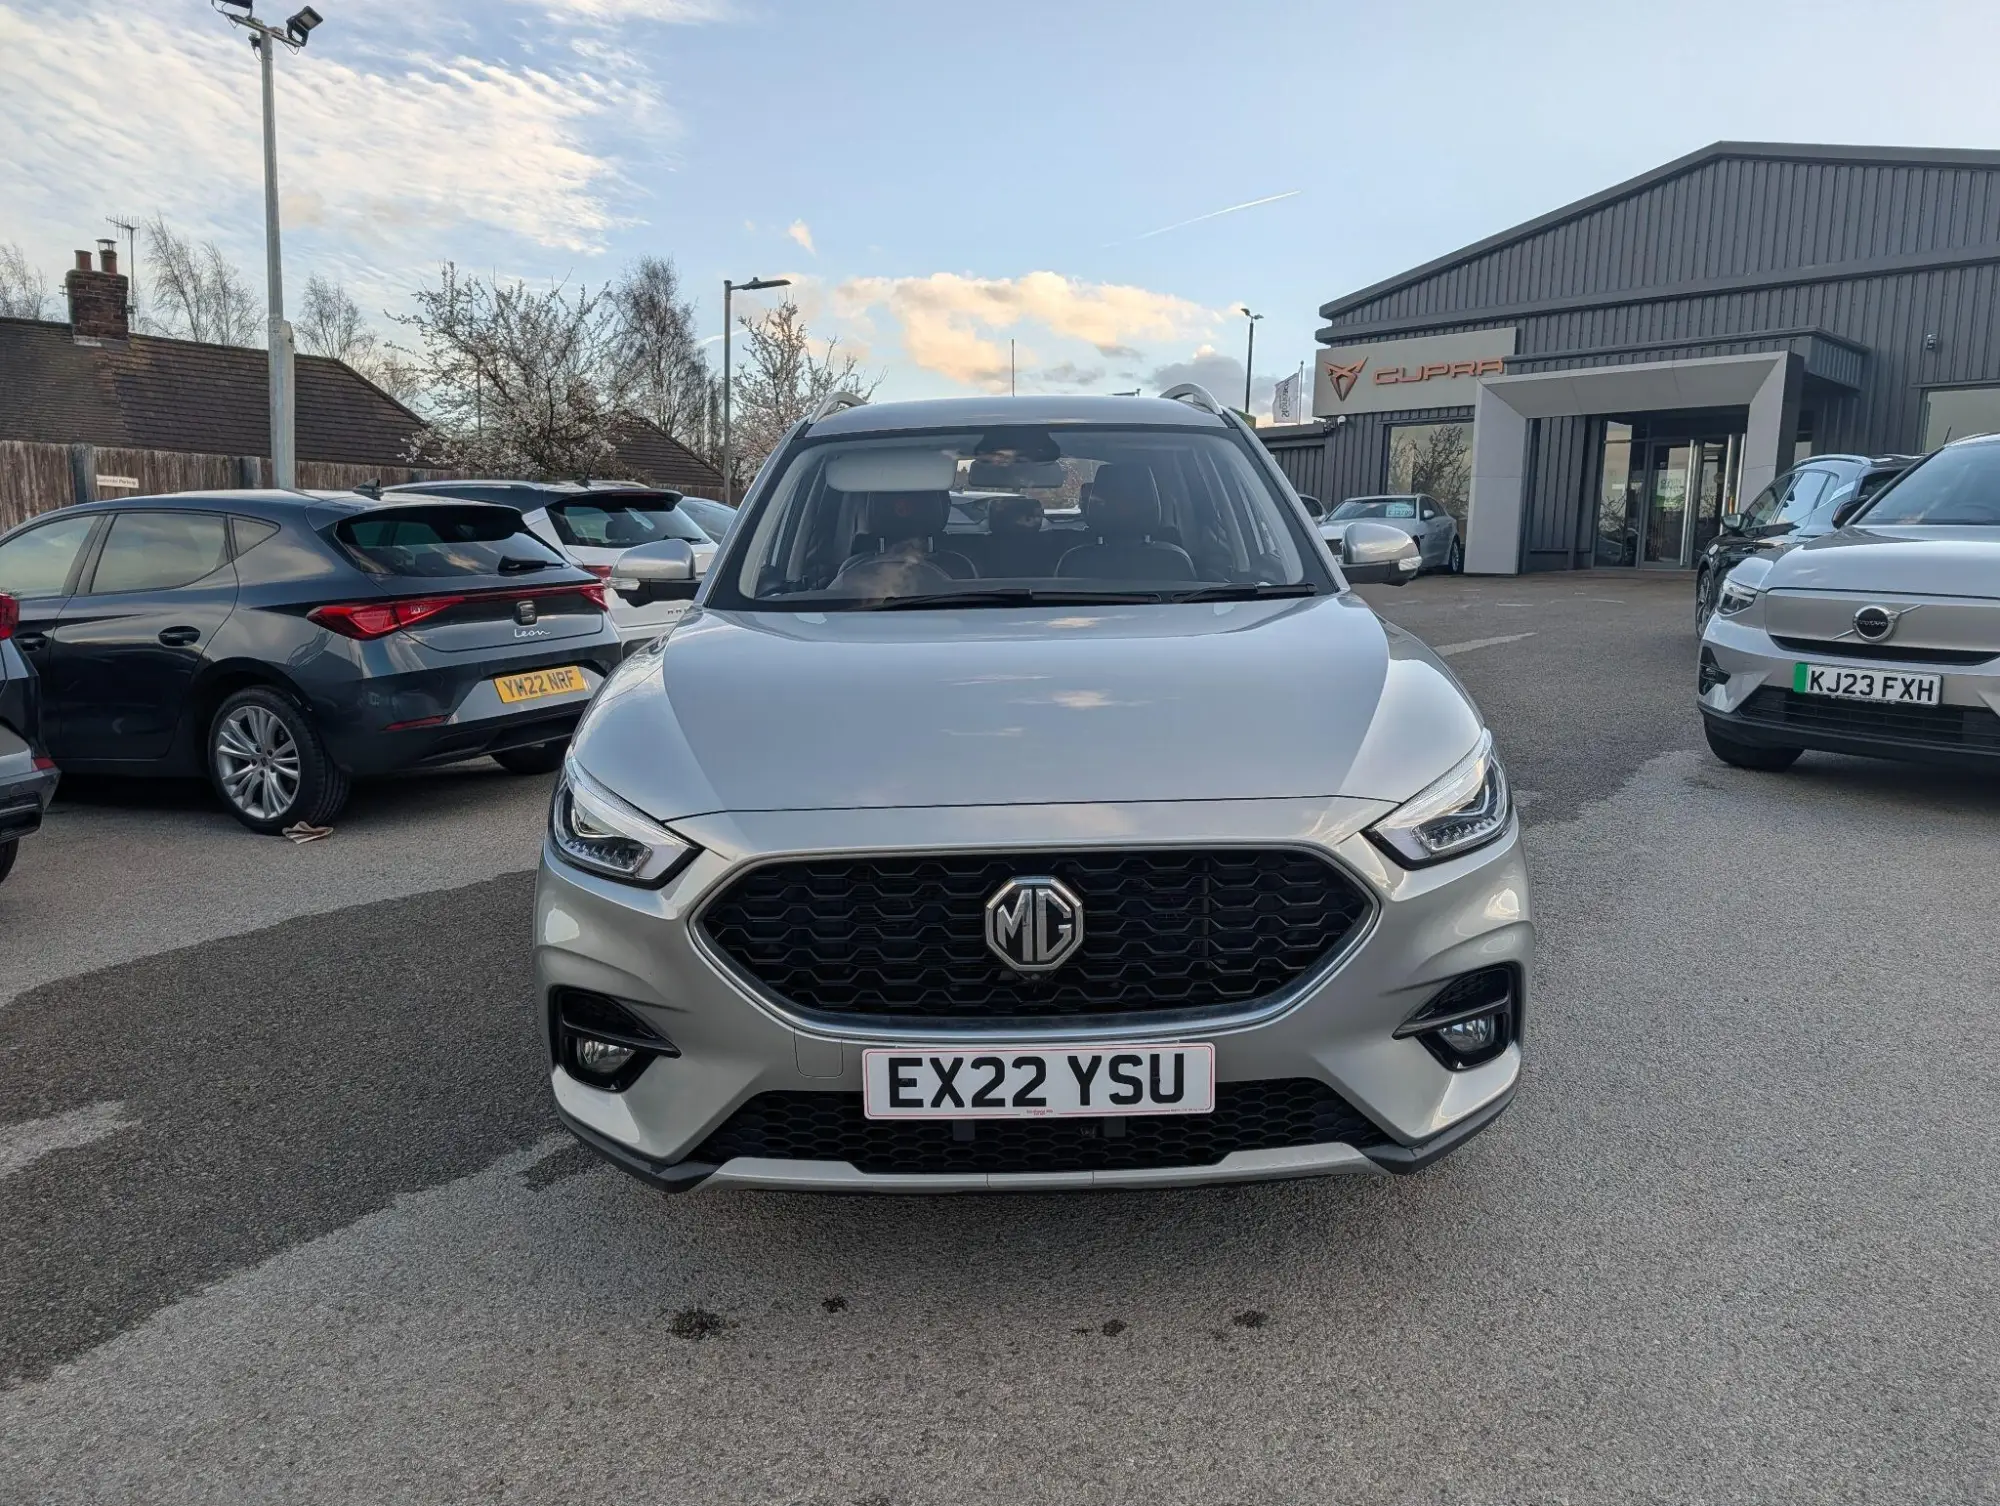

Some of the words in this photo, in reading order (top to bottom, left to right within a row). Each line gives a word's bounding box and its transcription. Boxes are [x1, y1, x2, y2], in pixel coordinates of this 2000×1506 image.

[1374, 358, 1504, 385] CUPRA
[514, 629, 550, 638] Leon
[548, 670, 575, 691] NRF
[1810, 670, 1874, 696] KJ23
[1882, 676, 1934, 701] FXH
[997, 889, 1072, 961] MG
[889, 1056, 1047, 1108] EX22
[1067, 1053, 1185, 1107] YSU
